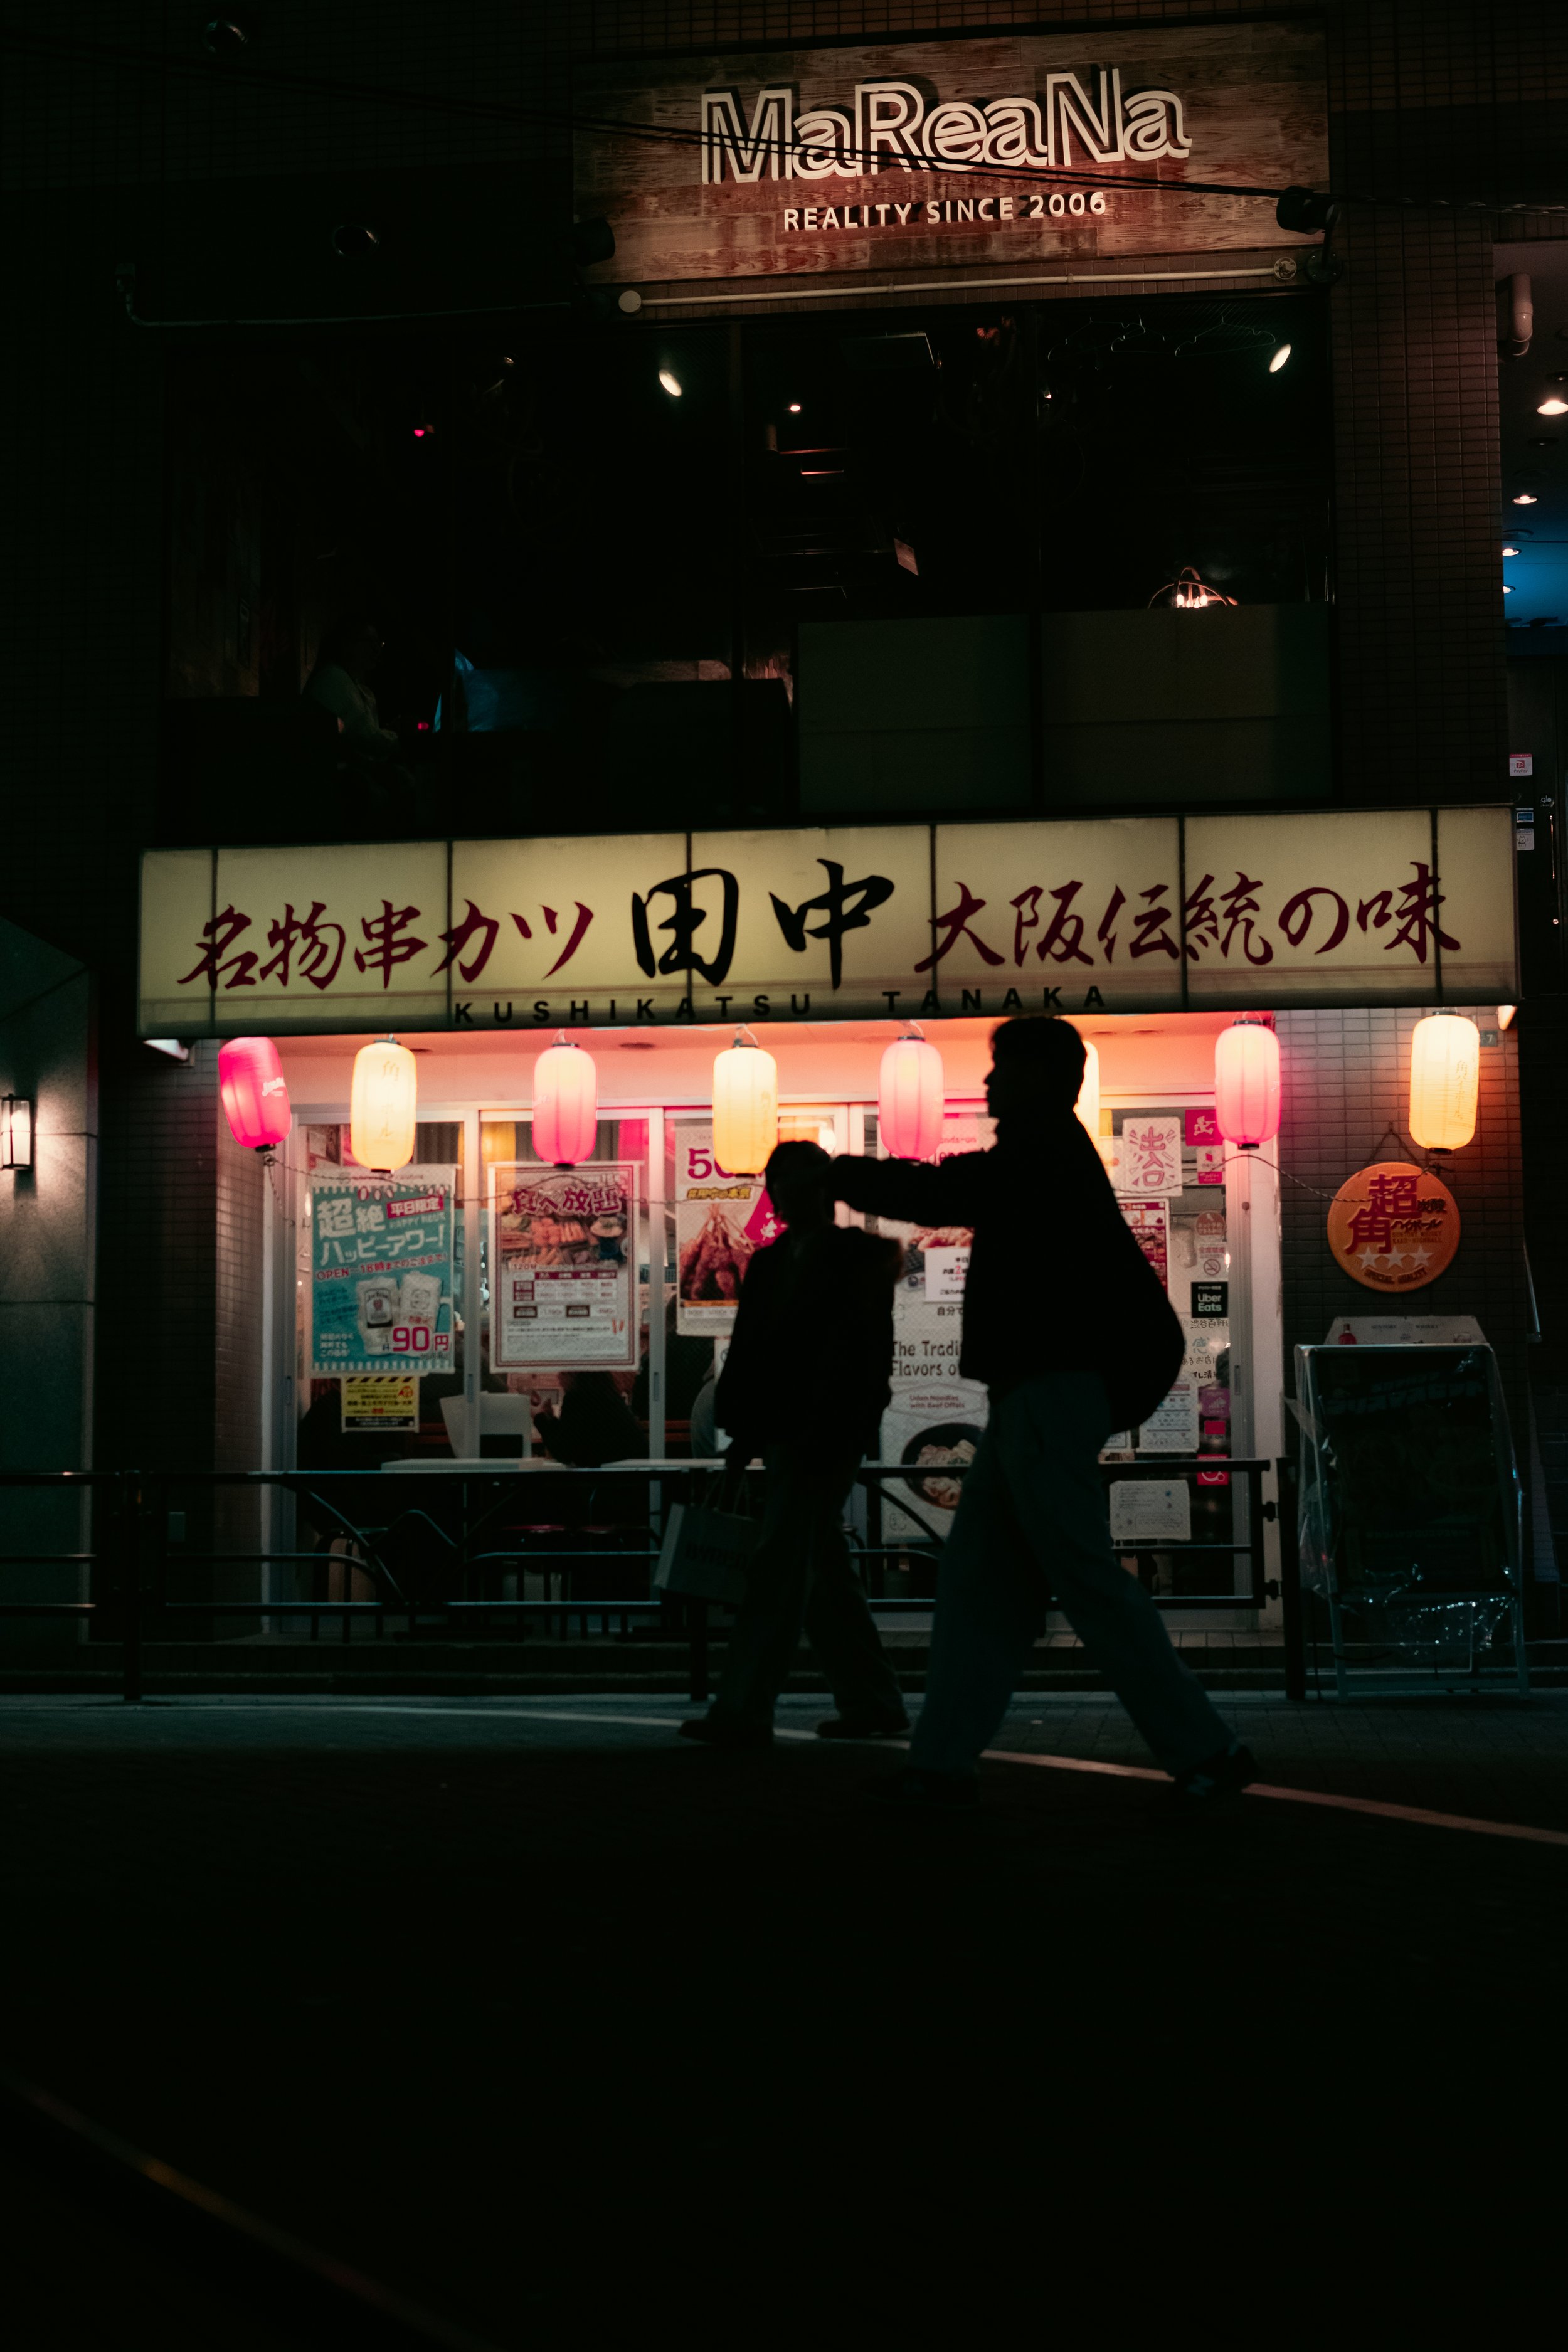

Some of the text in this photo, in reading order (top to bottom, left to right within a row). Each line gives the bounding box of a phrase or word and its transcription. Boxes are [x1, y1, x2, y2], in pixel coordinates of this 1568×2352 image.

[701, 66, 1192, 186] MaReaNa
[783, 191, 1106, 232] REALITY SINCE 2006
[177, 859, 1461, 990] 名物串カツ 田中 大阪伝統の味
[454, 985, 1106, 1025] KUSHIKATSU TANAKA
[1369, 1174, 1422, 1219] 超
[1345, 1208, 1391, 1254] 角
[1197, 1293, 1222, 1303] Uber
[1197, 1303, 1222, 1312] Eats
